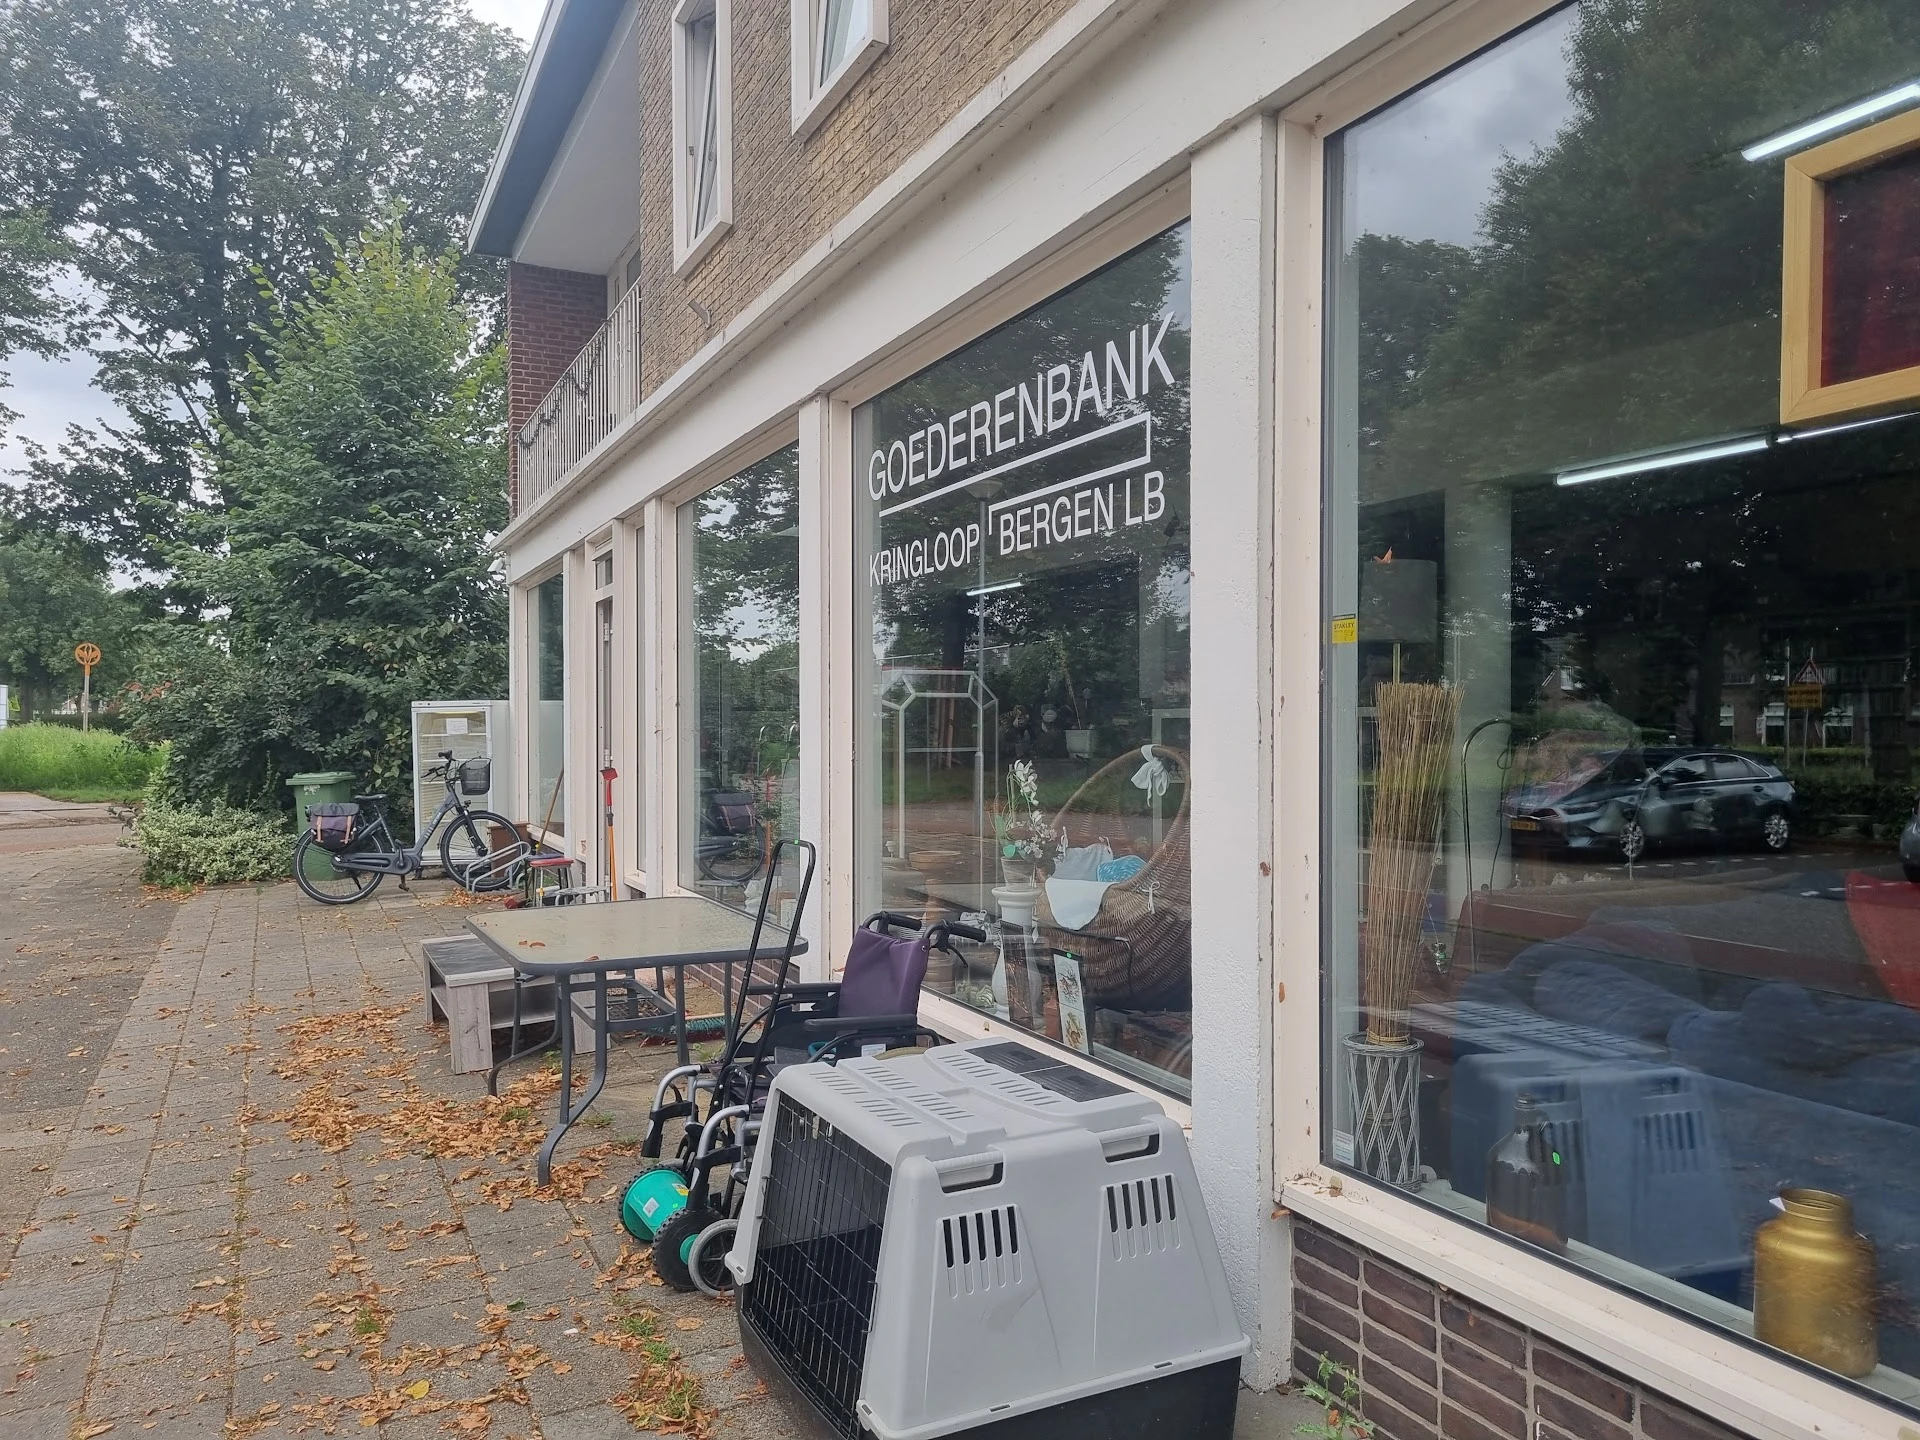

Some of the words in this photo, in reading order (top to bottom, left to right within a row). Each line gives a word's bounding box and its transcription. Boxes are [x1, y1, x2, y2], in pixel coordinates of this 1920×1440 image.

[868, 310, 1176, 501] GOEDERENBANK
[869, 523, 980, 588] KRINGLOOP
[1000, 482, 1114, 556] BERGEN
[1125, 470, 1165, 526] LB
